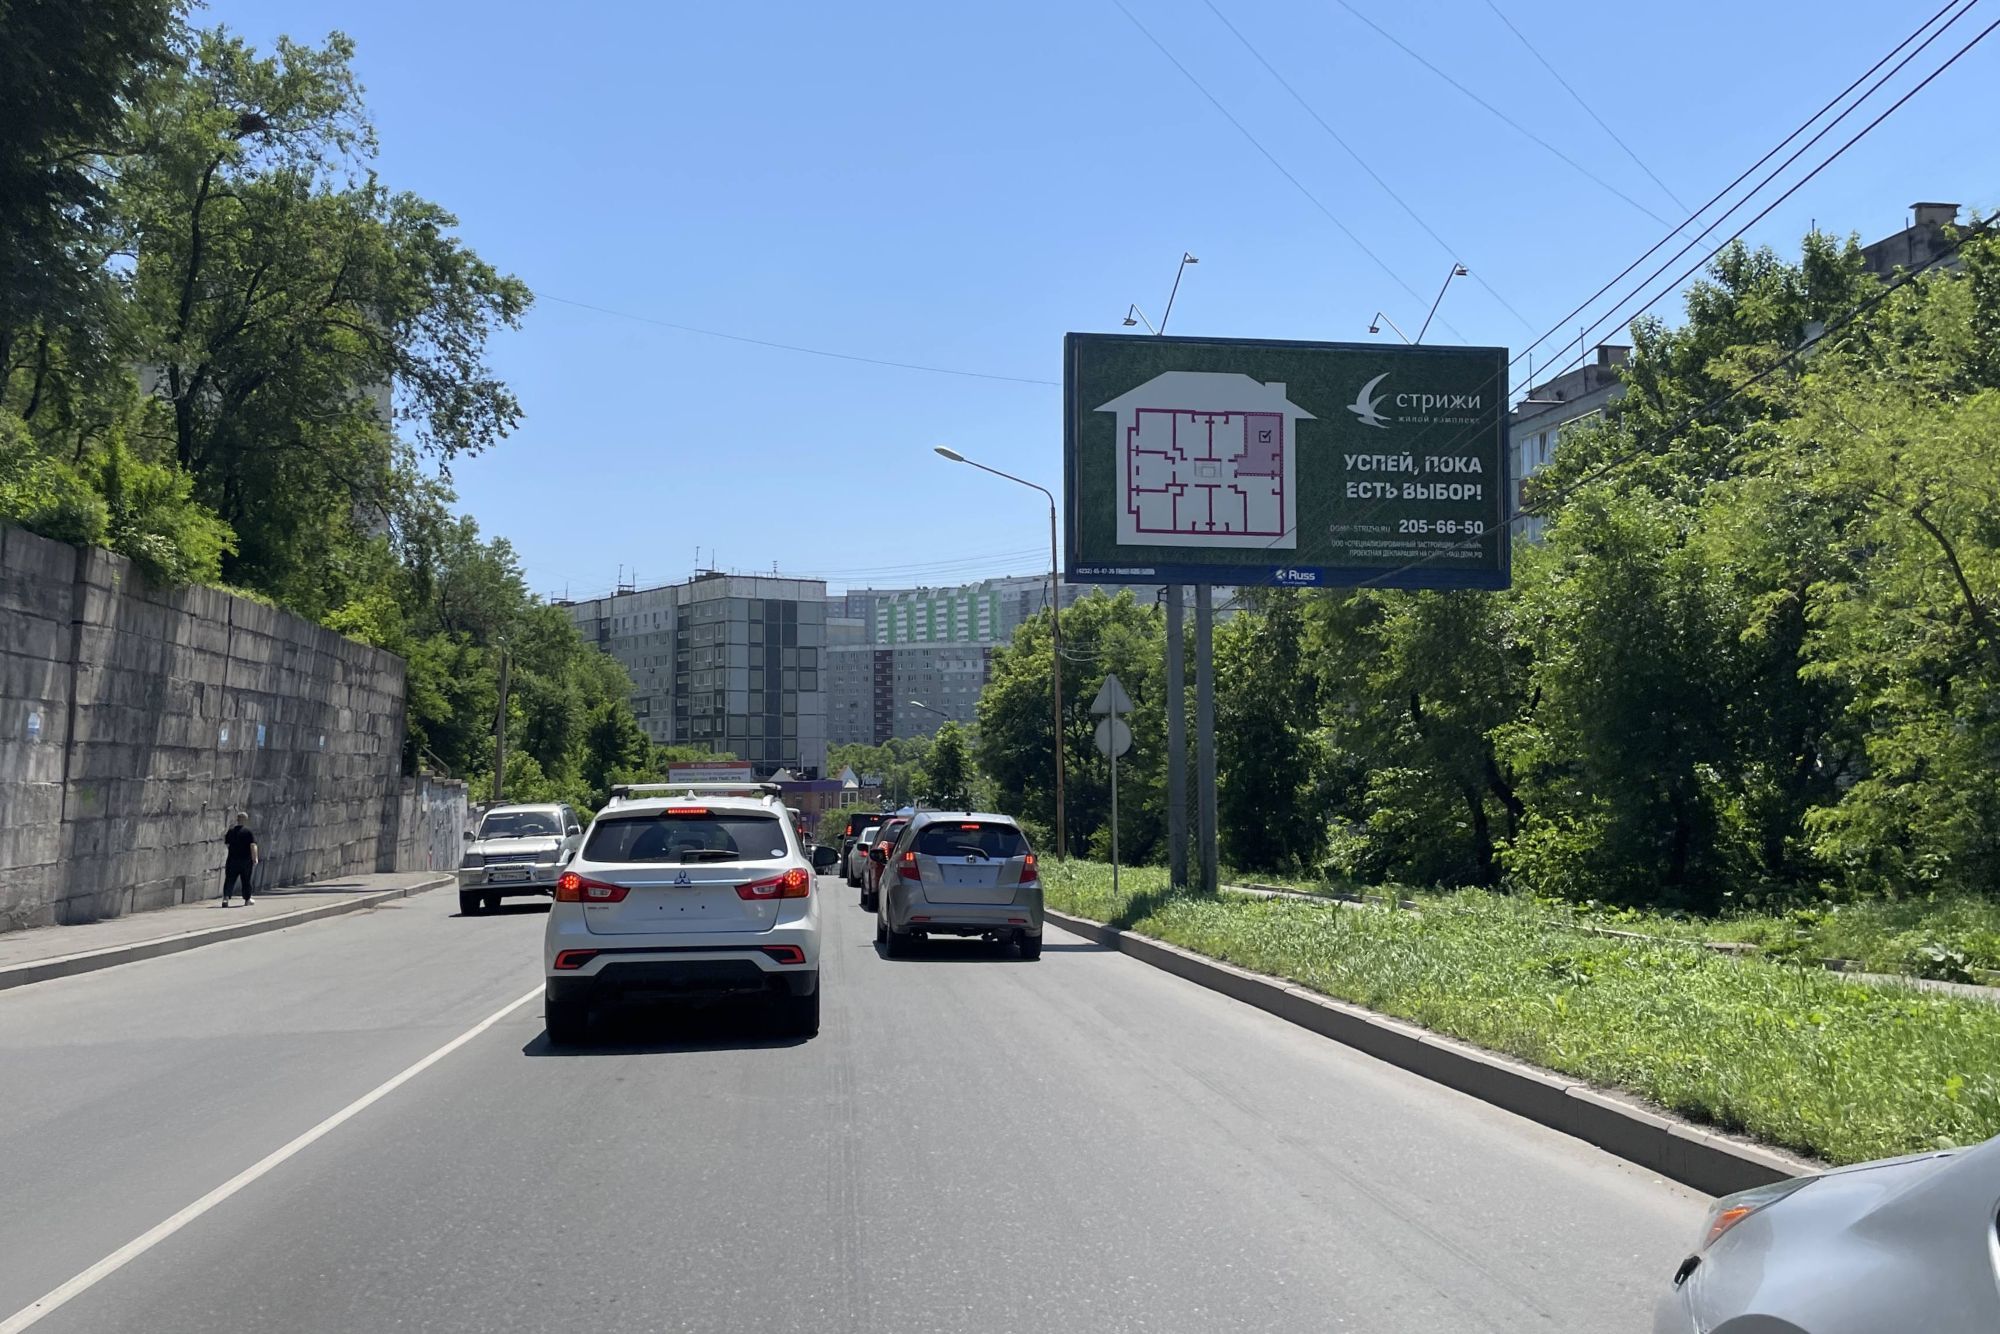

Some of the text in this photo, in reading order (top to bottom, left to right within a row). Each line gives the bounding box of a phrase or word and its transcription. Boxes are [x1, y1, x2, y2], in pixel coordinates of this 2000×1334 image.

[1396, 393, 1481, 413] стрижи
[1398, 415, 1430, 423] жилой
[1343, 451, 1483, 475] УСПЕЙ, ПОКА
[1346, 481, 1482, 500] ЕСТЬ ВЫБОР!
[1398, 519, 1484, 535] 205-66-50
[1288, 569, 1316, 581] Russ
